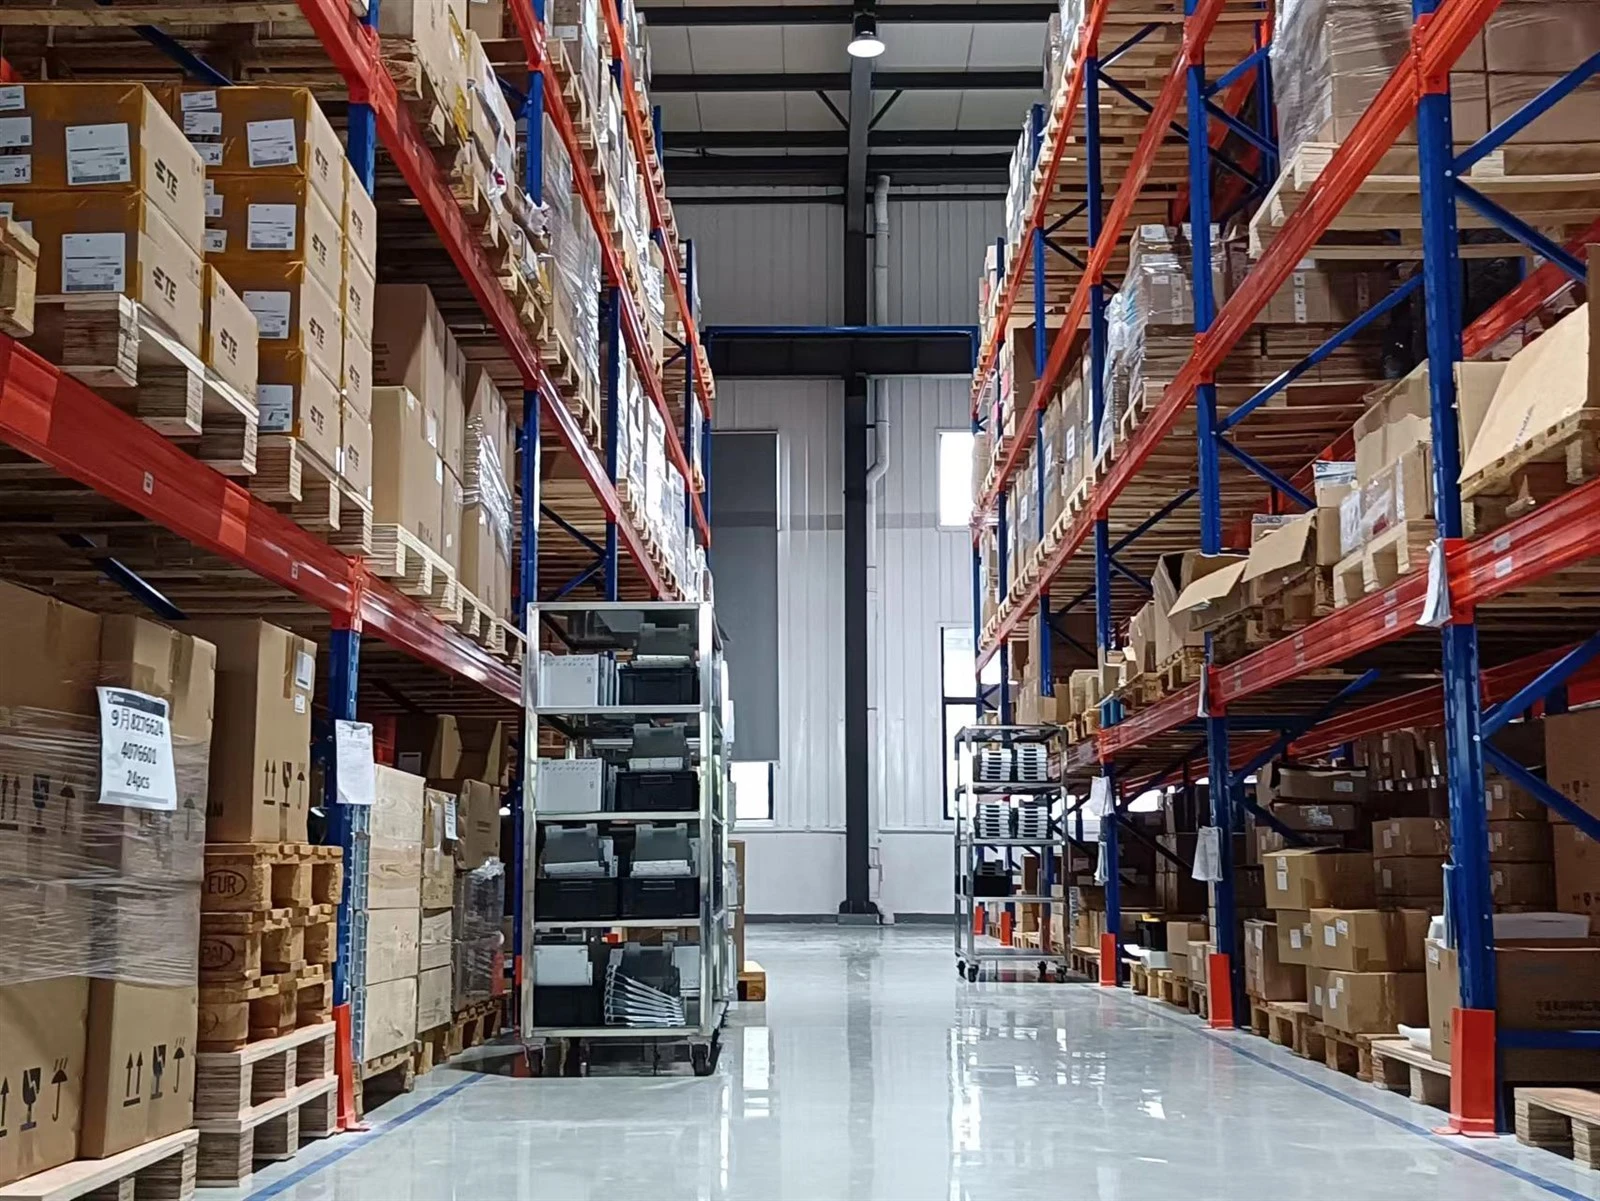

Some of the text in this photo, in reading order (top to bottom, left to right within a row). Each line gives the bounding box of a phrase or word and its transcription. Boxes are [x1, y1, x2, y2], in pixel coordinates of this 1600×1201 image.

[209, 152, 219, 160] 34
[14, 167, 26, 177] 31
[126, 770, 150, 791] 24pcs
[208, 875, 237, 894] EUR
